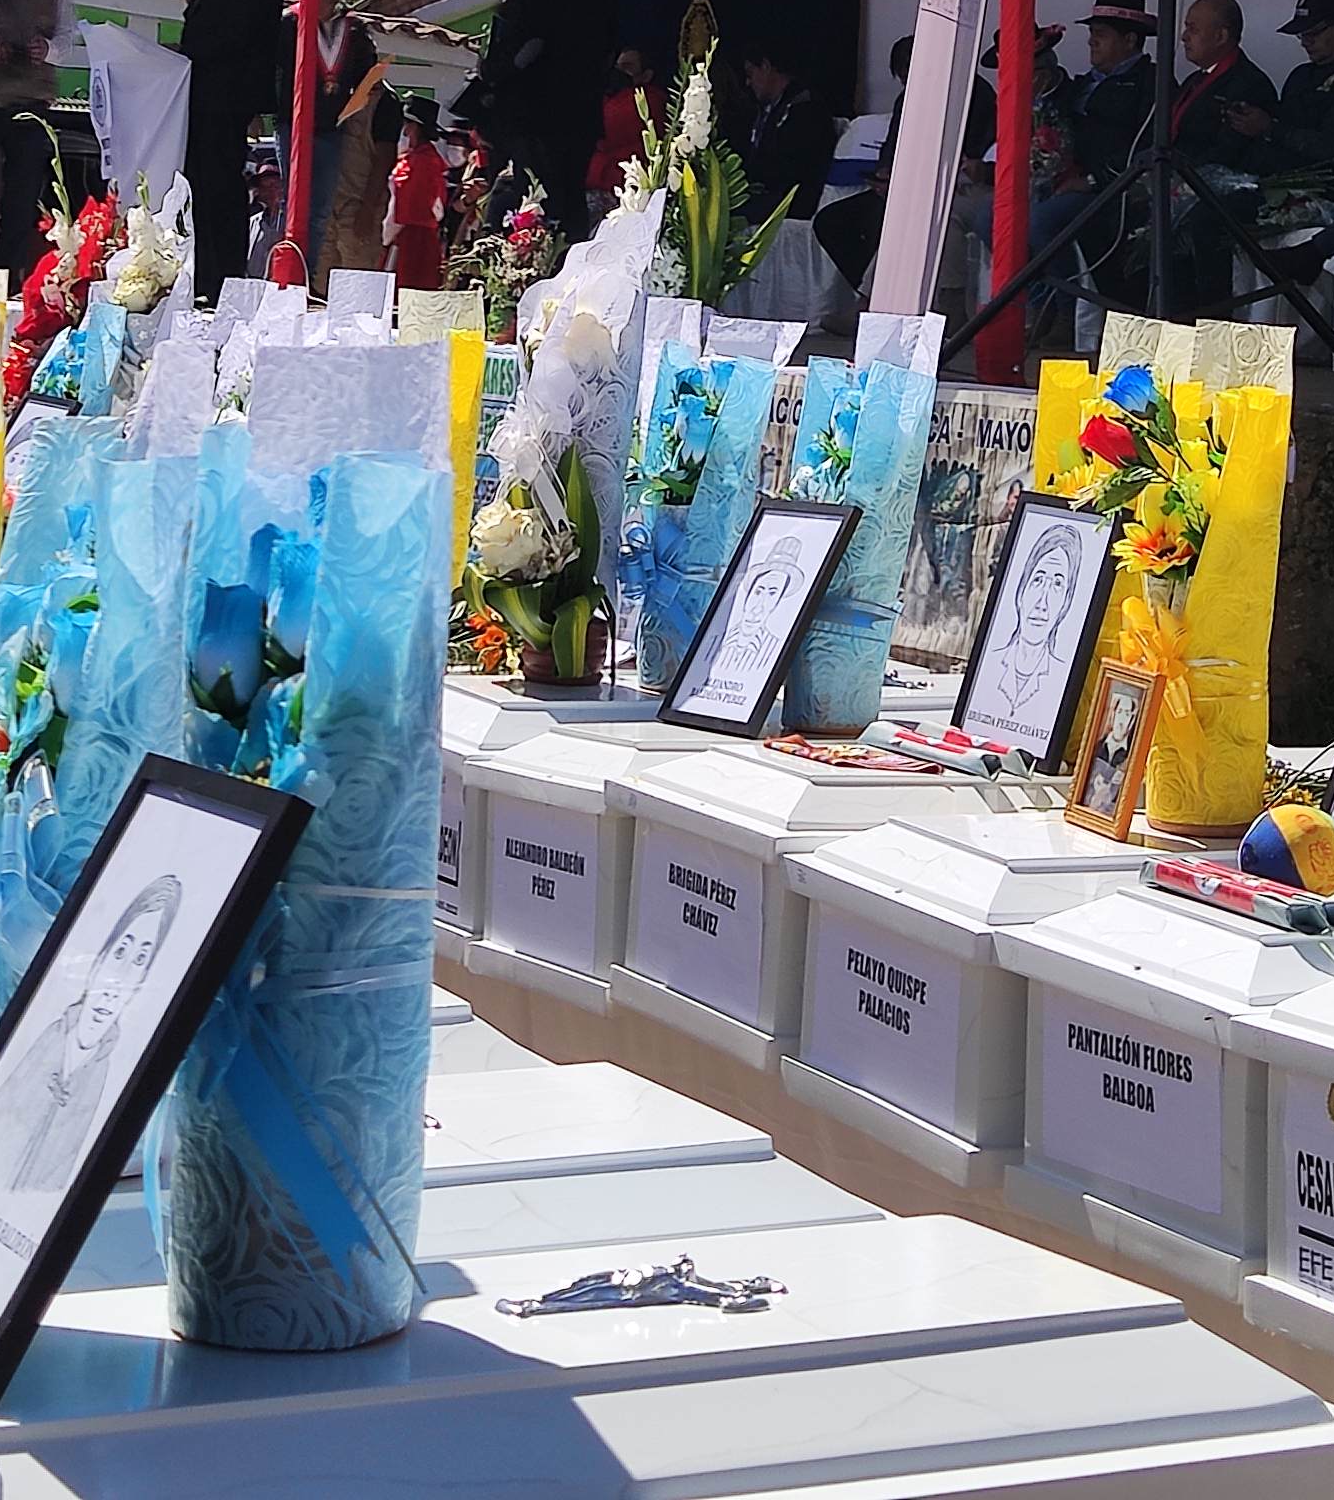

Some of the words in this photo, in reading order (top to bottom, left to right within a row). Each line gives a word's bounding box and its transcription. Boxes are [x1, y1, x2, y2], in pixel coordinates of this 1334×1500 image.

[975, 418, 1032, 452] MAYO
[504, 837, 549, 867] ALEJANDRO
[548, 847, 585, 877] BALDEÓN
[531, 873, 556, 901] PÉREZ
[668, 862, 709, 899] BRIGIDA
[709, 878, 737, 911] PÉREZ
[682, 901, 719, 937] CHÁVEZ
[847, 947, 886, 986] PELAYO
[887, 965, 927, 1006] QUISPE
[858, 988, 911, 1035] PALACIOS
[1068, 1023, 1141, 1068] PANTALEÓN
[1143, 1045, 1192, 1083] FLORES
[1102, 1073, 1155, 1113] BALBOA
[1299, 1246, 1333, 1281] EFE
